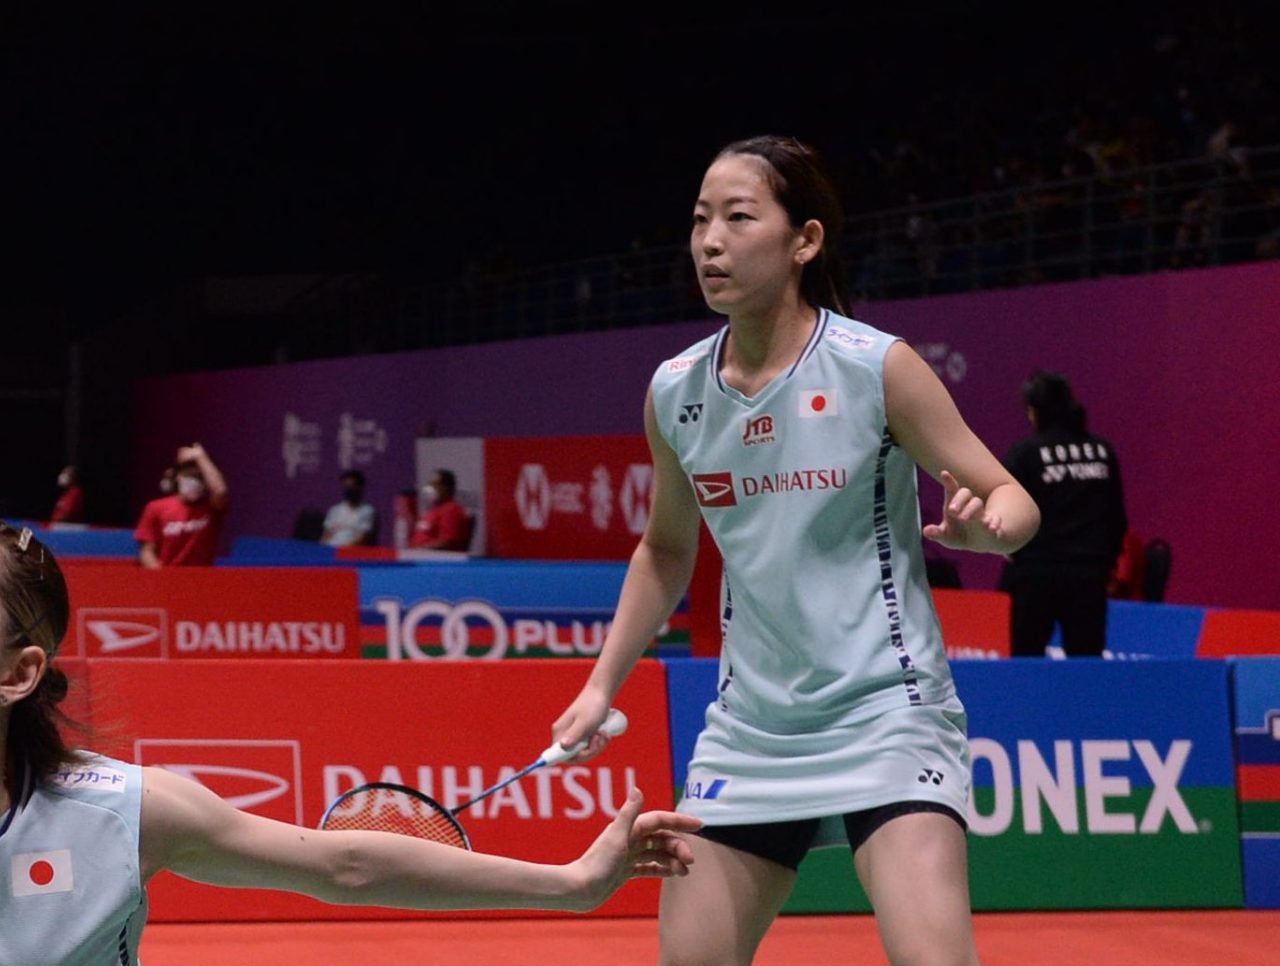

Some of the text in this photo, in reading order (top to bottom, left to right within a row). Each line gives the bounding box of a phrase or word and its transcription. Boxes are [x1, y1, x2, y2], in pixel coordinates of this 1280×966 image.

[743, 415, 774, 440] JTB
[742, 469, 848, 497] DAIHATSU
[175, 620, 346, 653] DAIHATSU
[375, 598, 610, 661] 100 PLU
[58, 769, 125, 785] イフカード
[685, 782, 702, 800] NA
[969, 739, 1200, 837] ONEX
[322, 764, 636, 822] DAIHATSU
